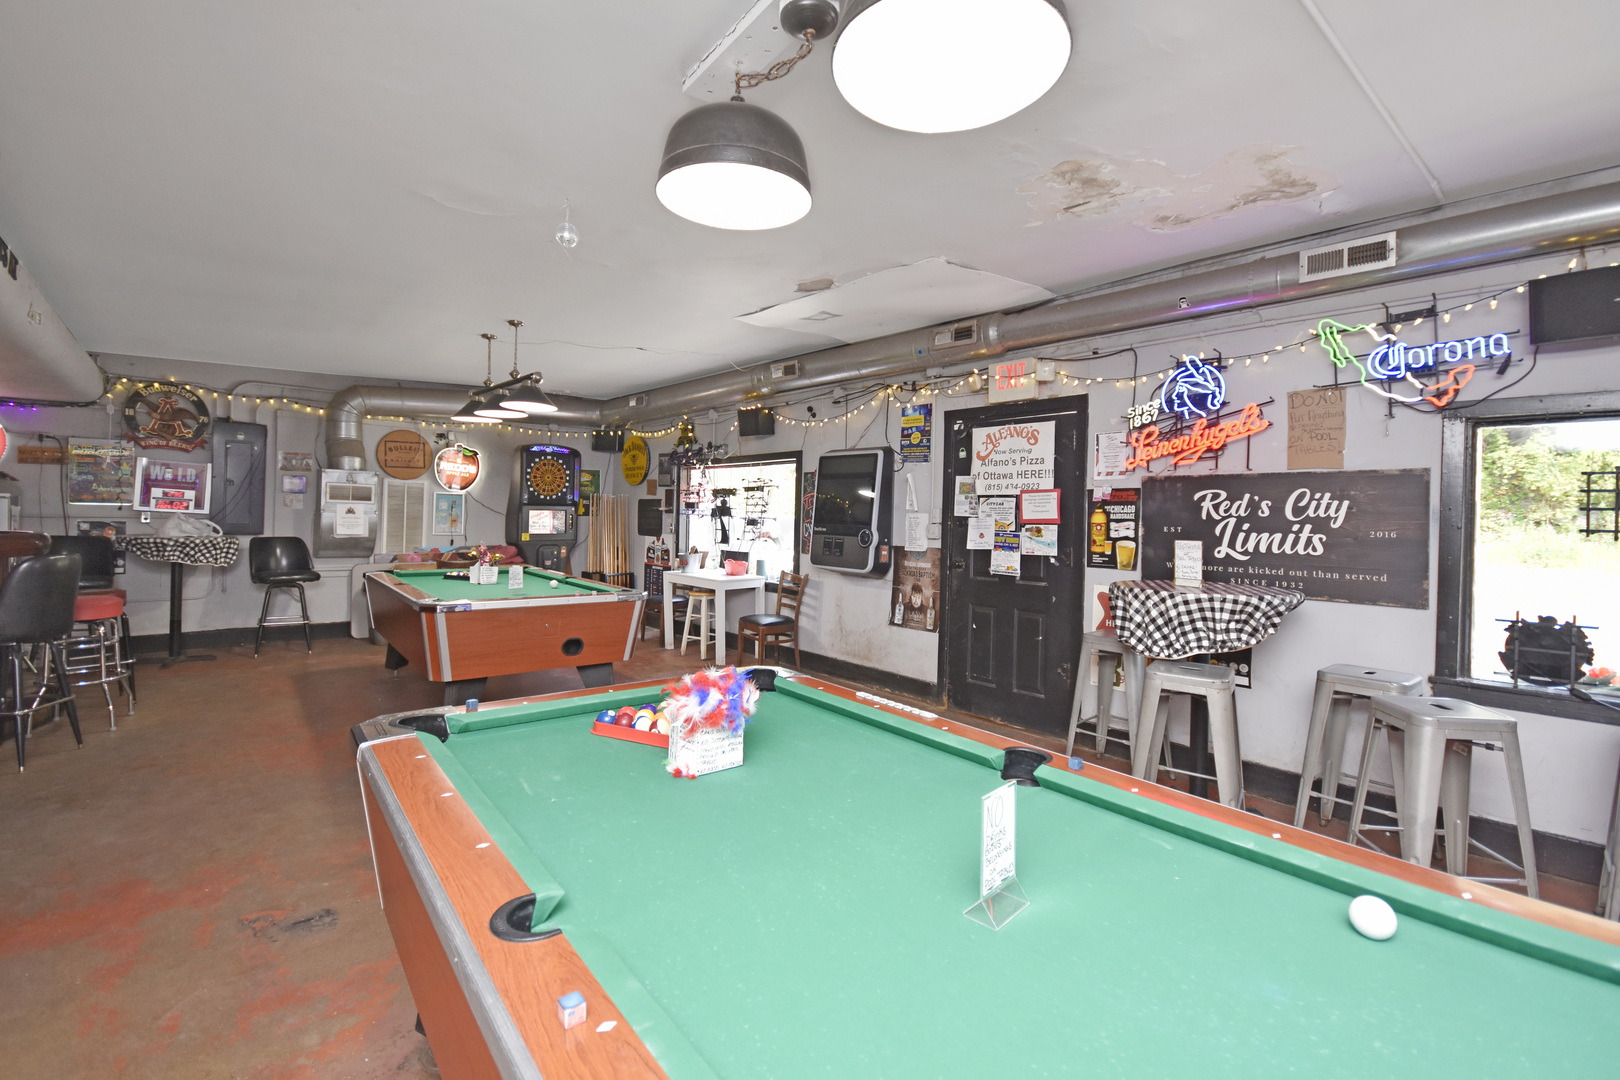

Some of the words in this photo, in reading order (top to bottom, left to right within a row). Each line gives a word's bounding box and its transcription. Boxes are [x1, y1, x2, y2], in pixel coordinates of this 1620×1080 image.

[1367, 333, 1512, 379] Corona
[996, 361, 1027, 391] EXIT
[138, 385, 198, 402] Budweiser
[1316, 389, 1345, 406] NOT
[125, 408, 134, 416] 18
[1129, 409, 1159, 430] 1867
[976, 425, 1040, 461] ALFANO'S
[1307, 431, 1338, 441] POOL
[1008, 447, 1033, 455] Serving
[980, 457, 1017, 467] Alfano's
[1020, 456, 1045, 465] Pizza
[983, 471, 1013, 480] Ottawa
[1017, 469, 1054, 479] HERE!!!
[985, 483, 1003, 492] (815)
[1005, 482, 1040, 490] 434-0923
[1110, 505, 1136, 513] CHICAGO
[1193, 489, 1272, 520] Red's
[1285, 488, 1350, 528] City
[1214, 518, 1327, 561] Limits
[1369, 530, 1397, 538] 2016
[1228, 566, 1245, 574] are
[1248, 566, 1284, 576] kicked
[1289, 569, 1308, 577] out
[1312, 570, 1339, 580] than
[1345, 573, 1388, 583] served
[1230, 578, 1268, 586] SINCE
[1275, 581, 1304, 589] 1932
[986, 795, 1004, 835] NO
